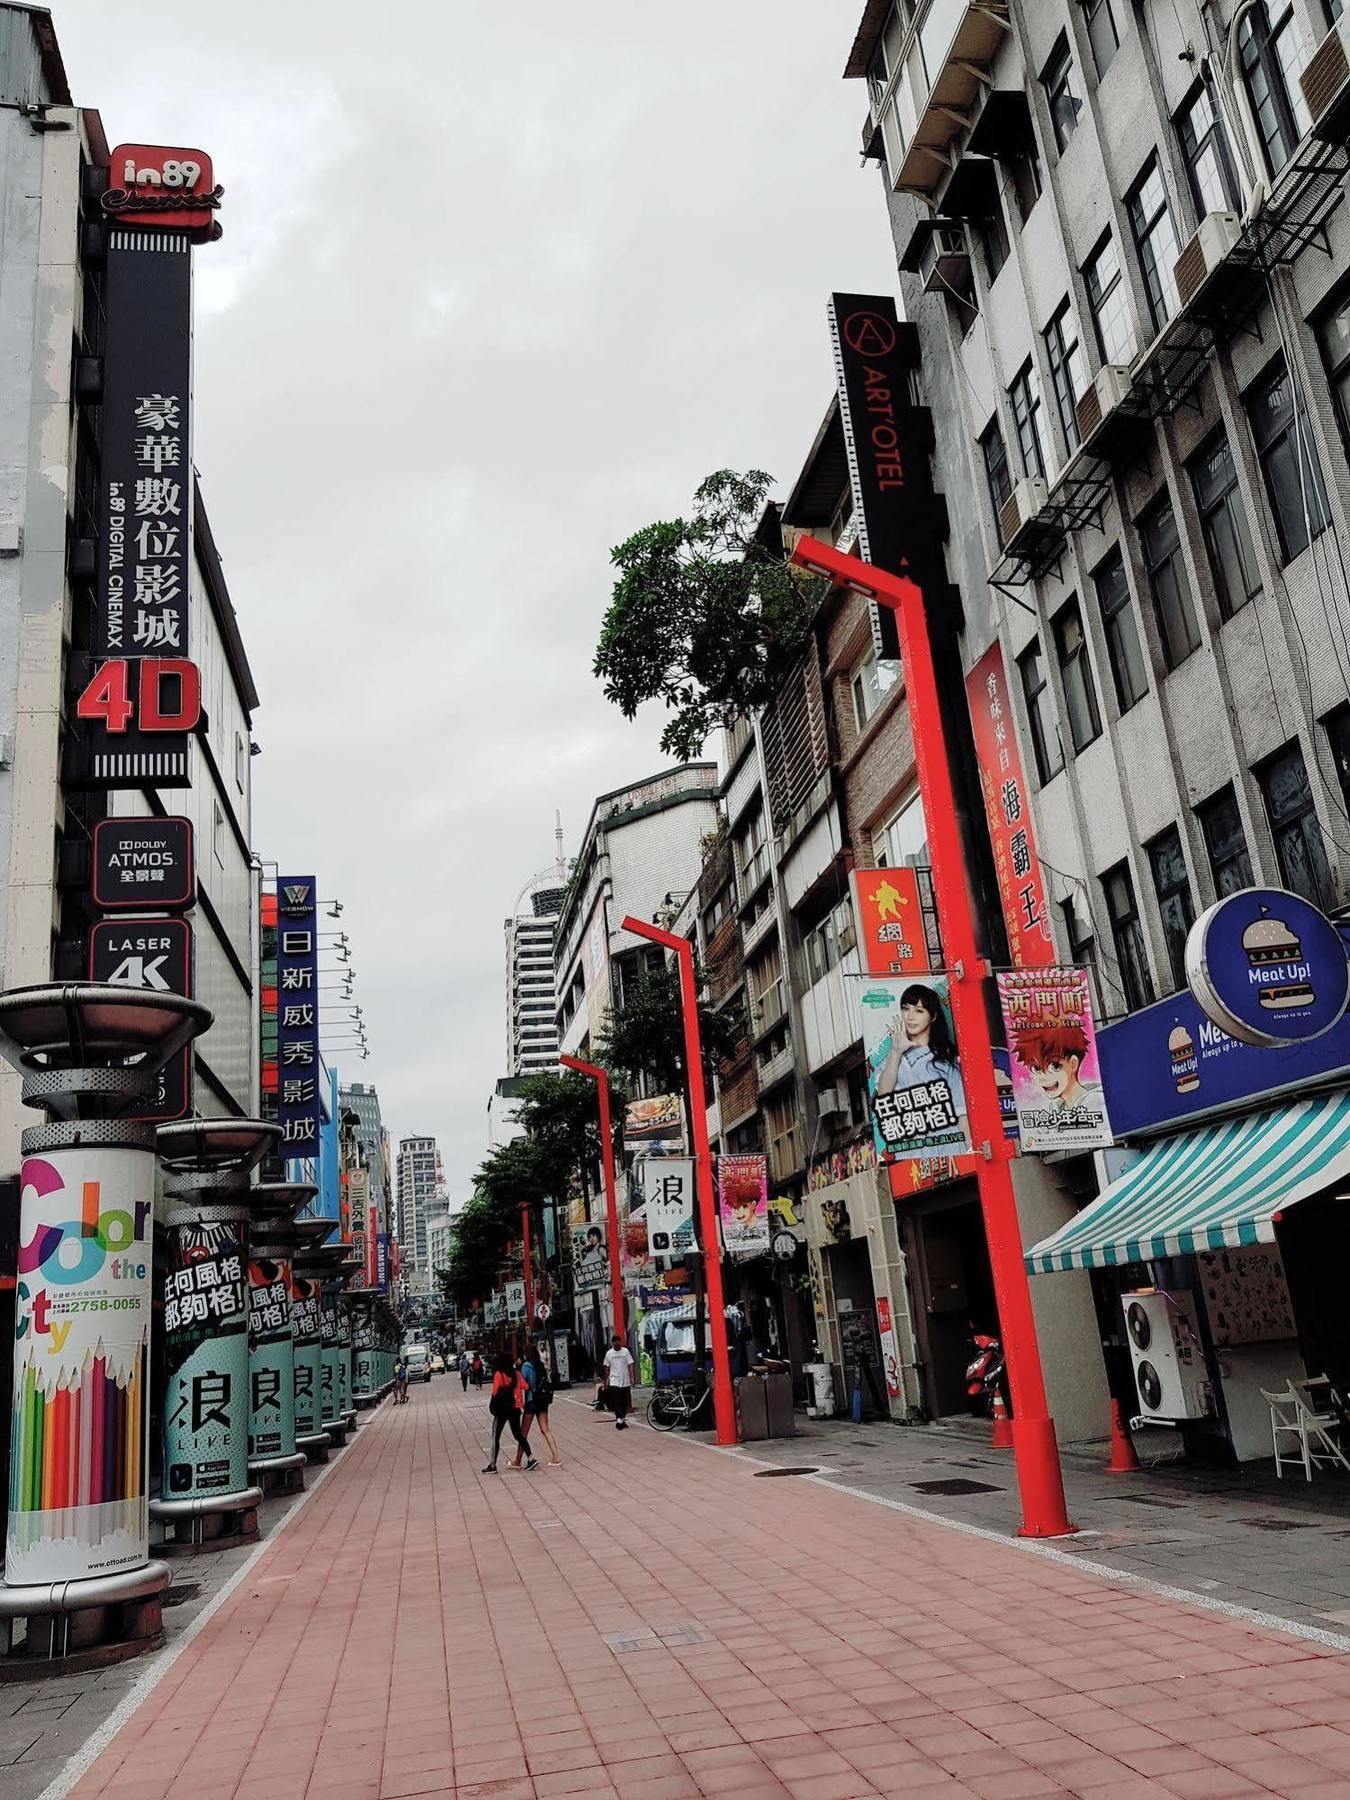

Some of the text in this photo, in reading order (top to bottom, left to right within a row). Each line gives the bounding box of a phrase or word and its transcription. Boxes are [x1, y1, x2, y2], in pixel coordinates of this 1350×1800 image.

[124, 159, 201, 188] in89
[861, 365, 905, 492] ART'OTEL
[132, 393, 182, 648] 豪華數位影城
[106, 482, 126, 649] in89 DIGITAL CINEMAX
[77, 657, 201, 733] 4D
[108, 851, 174, 867] ATMOS
[134, 840, 167, 849] DOLBY
[108, 938, 171, 951] LASER
[107, 955, 170, 990] 4K
[1248, 962, 1311, 984] Meat Up!
[1006, 990, 1085, 1019] 西門町
[281, 930, 315, 1142] 日新威秀影城
[1171, 1061, 1188, 1076] Meat
[875, 1081, 949, 1118] 任何風格
[881, 1102, 955, 1141] 都夠格!
[650, 1175, 683, 1207] 浪
[18, 1158, 151, 1285] Color
[111, 1258, 146, 1279] the
[71, 1298, 141, 1313] 2758-0055
[169, 1370, 231, 1433] 浪
[177, 1433, 231, 1450] LIVE
